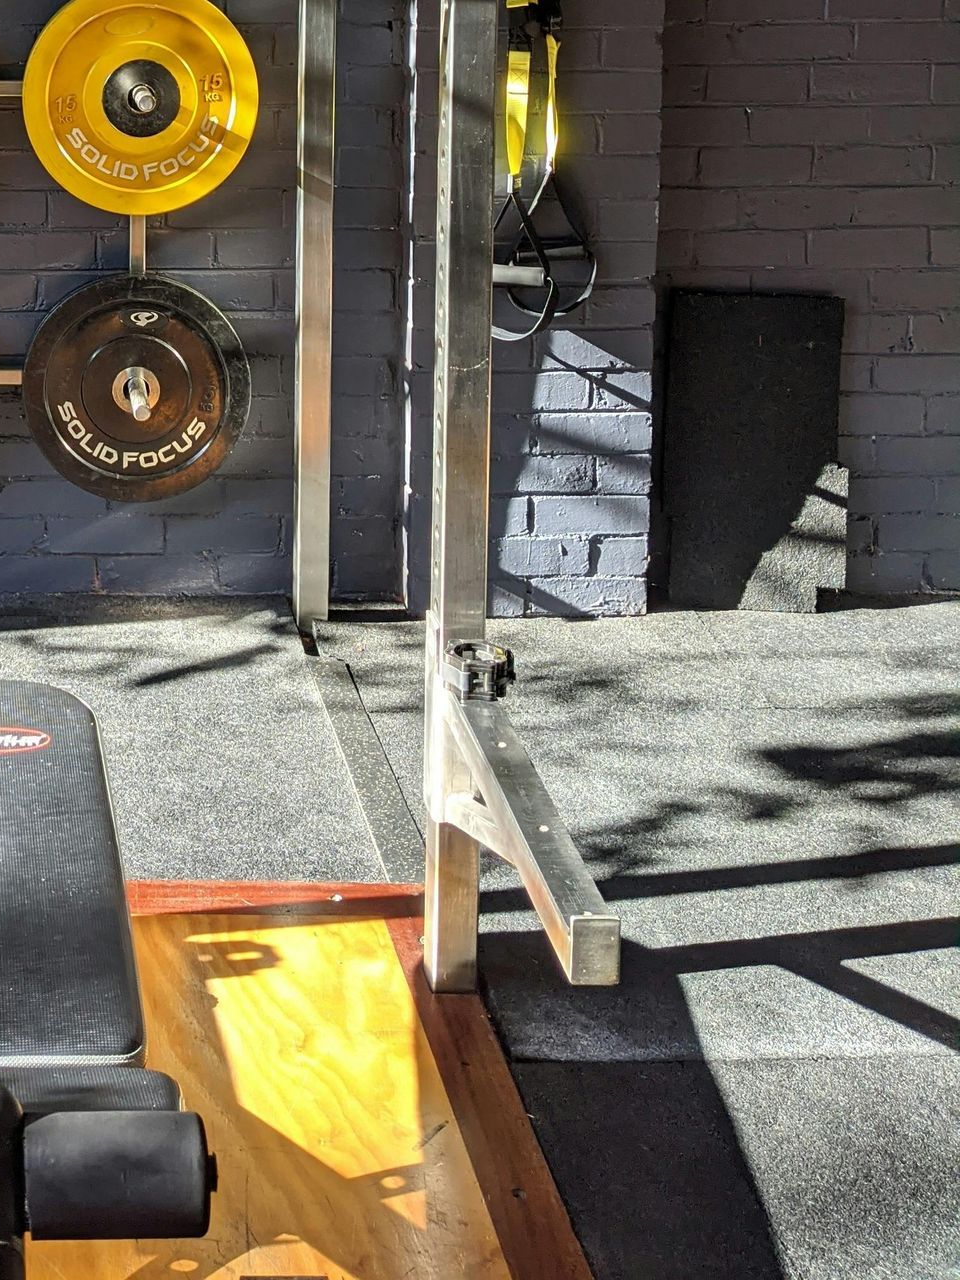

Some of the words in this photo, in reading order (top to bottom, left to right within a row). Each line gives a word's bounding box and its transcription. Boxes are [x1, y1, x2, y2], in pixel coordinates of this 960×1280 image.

[55, 94, 76, 113] 15
[200, 73, 223, 91] 15
[66, 127, 139, 181] SOLID
[143, 113, 219, 182] FOCUS
[57, 401, 119, 465] SOLID
[122, 416, 206, 469] FOCUS
